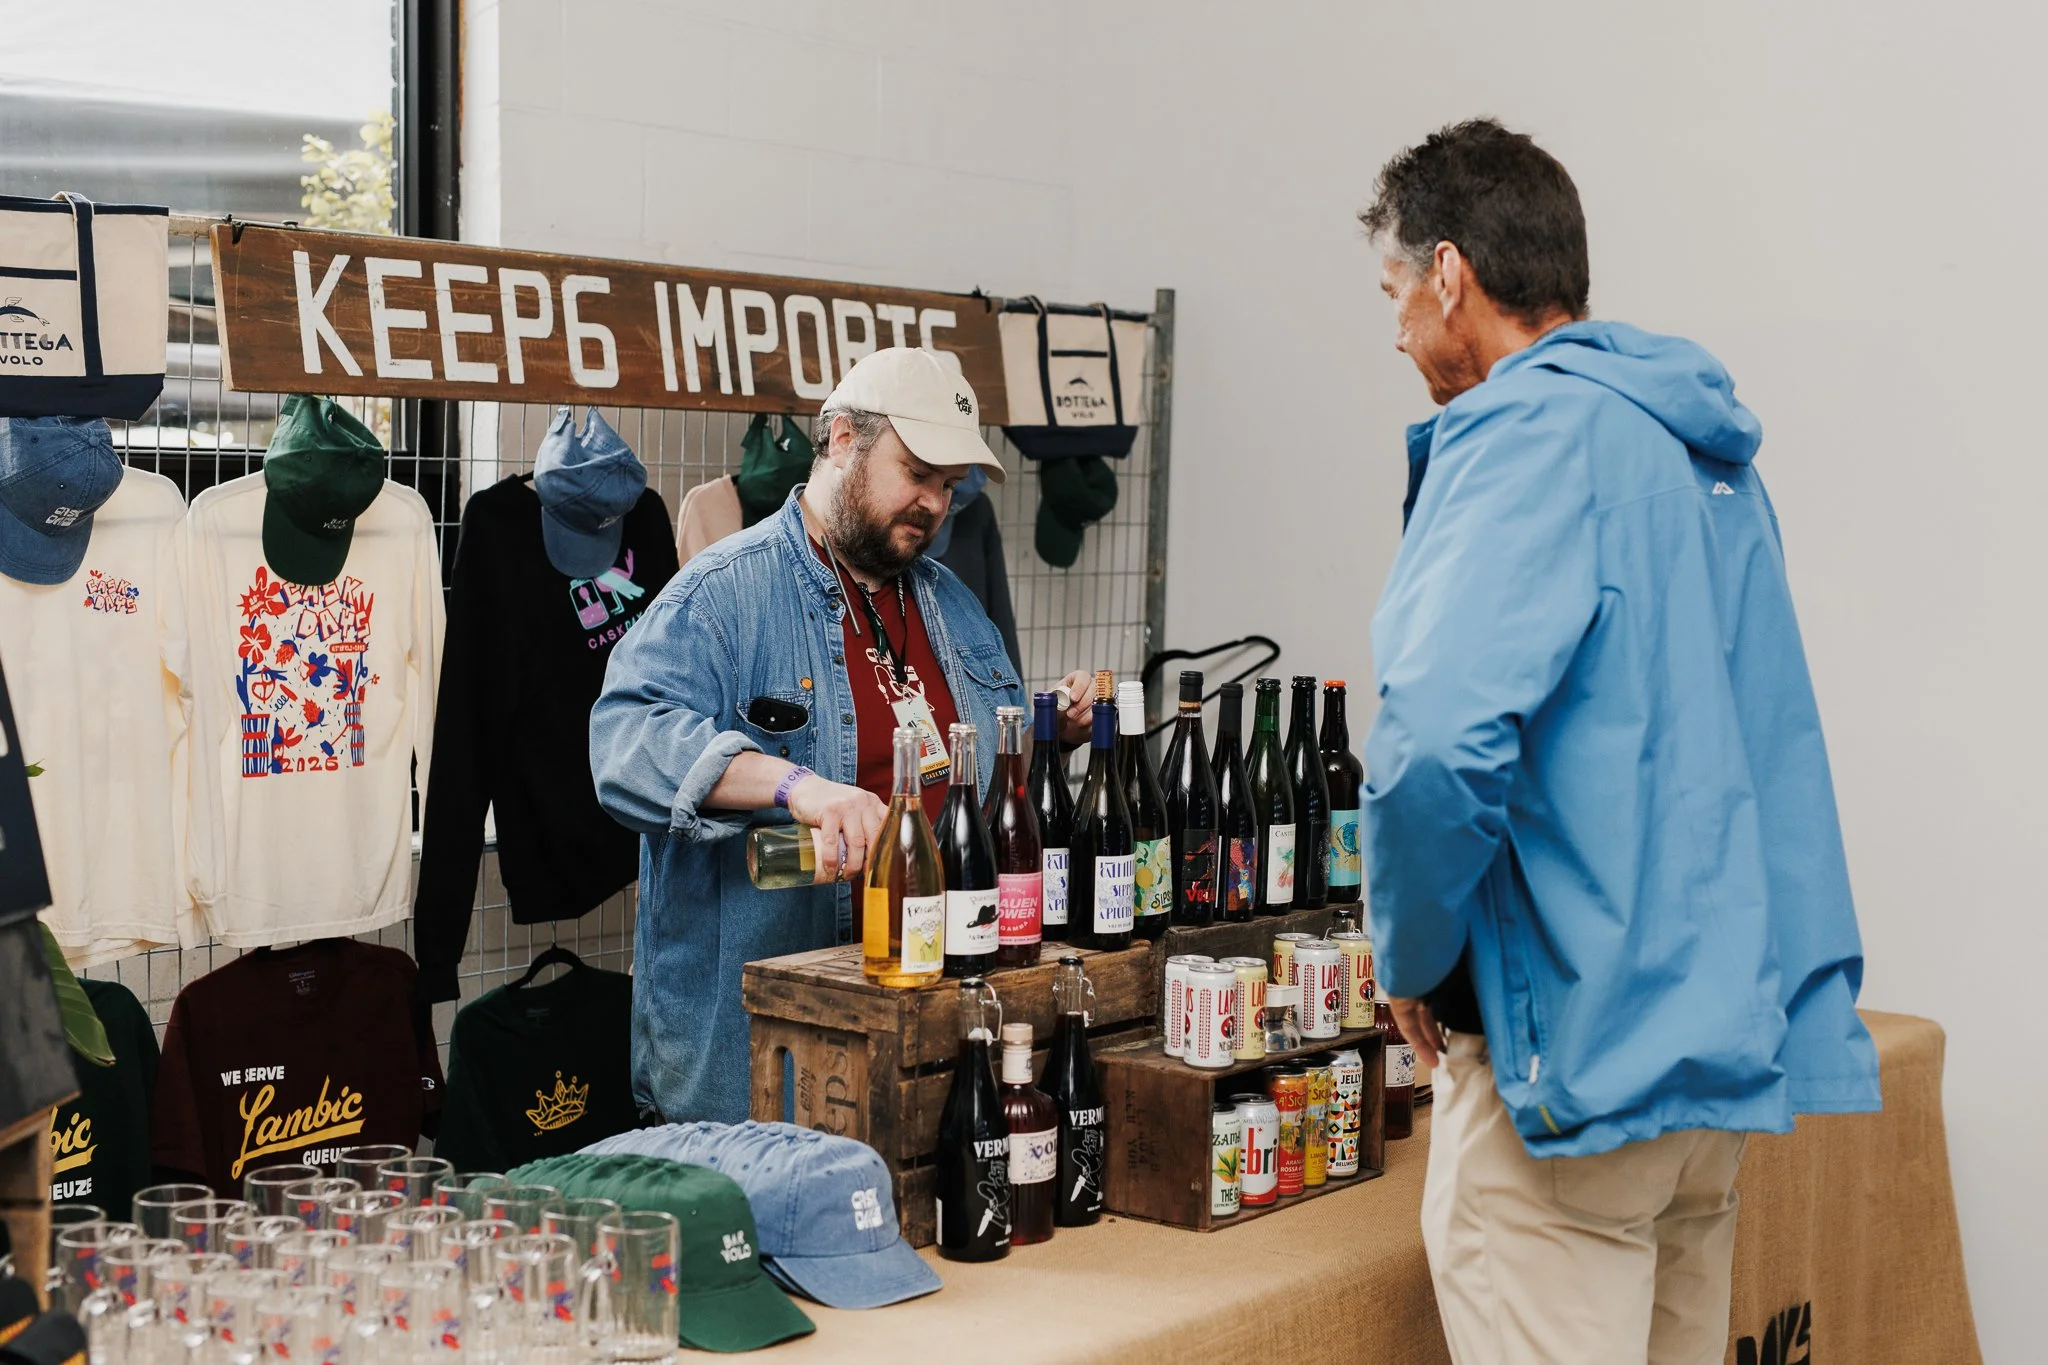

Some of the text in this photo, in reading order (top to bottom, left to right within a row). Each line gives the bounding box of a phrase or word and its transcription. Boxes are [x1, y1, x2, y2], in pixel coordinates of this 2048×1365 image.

[292, 250, 619, 388] KEEP6
[86, 579, 131, 595] CASK
[93, 594, 137, 614] DAYS
[296, 608, 371, 643] DAYS
[220, 1066, 285, 1087] WE SERVE
[231, 1075, 366, 1180] Lambic
[302, 1146, 360, 1166] GUEU
[49, 1177, 92, 1200] EUZE
